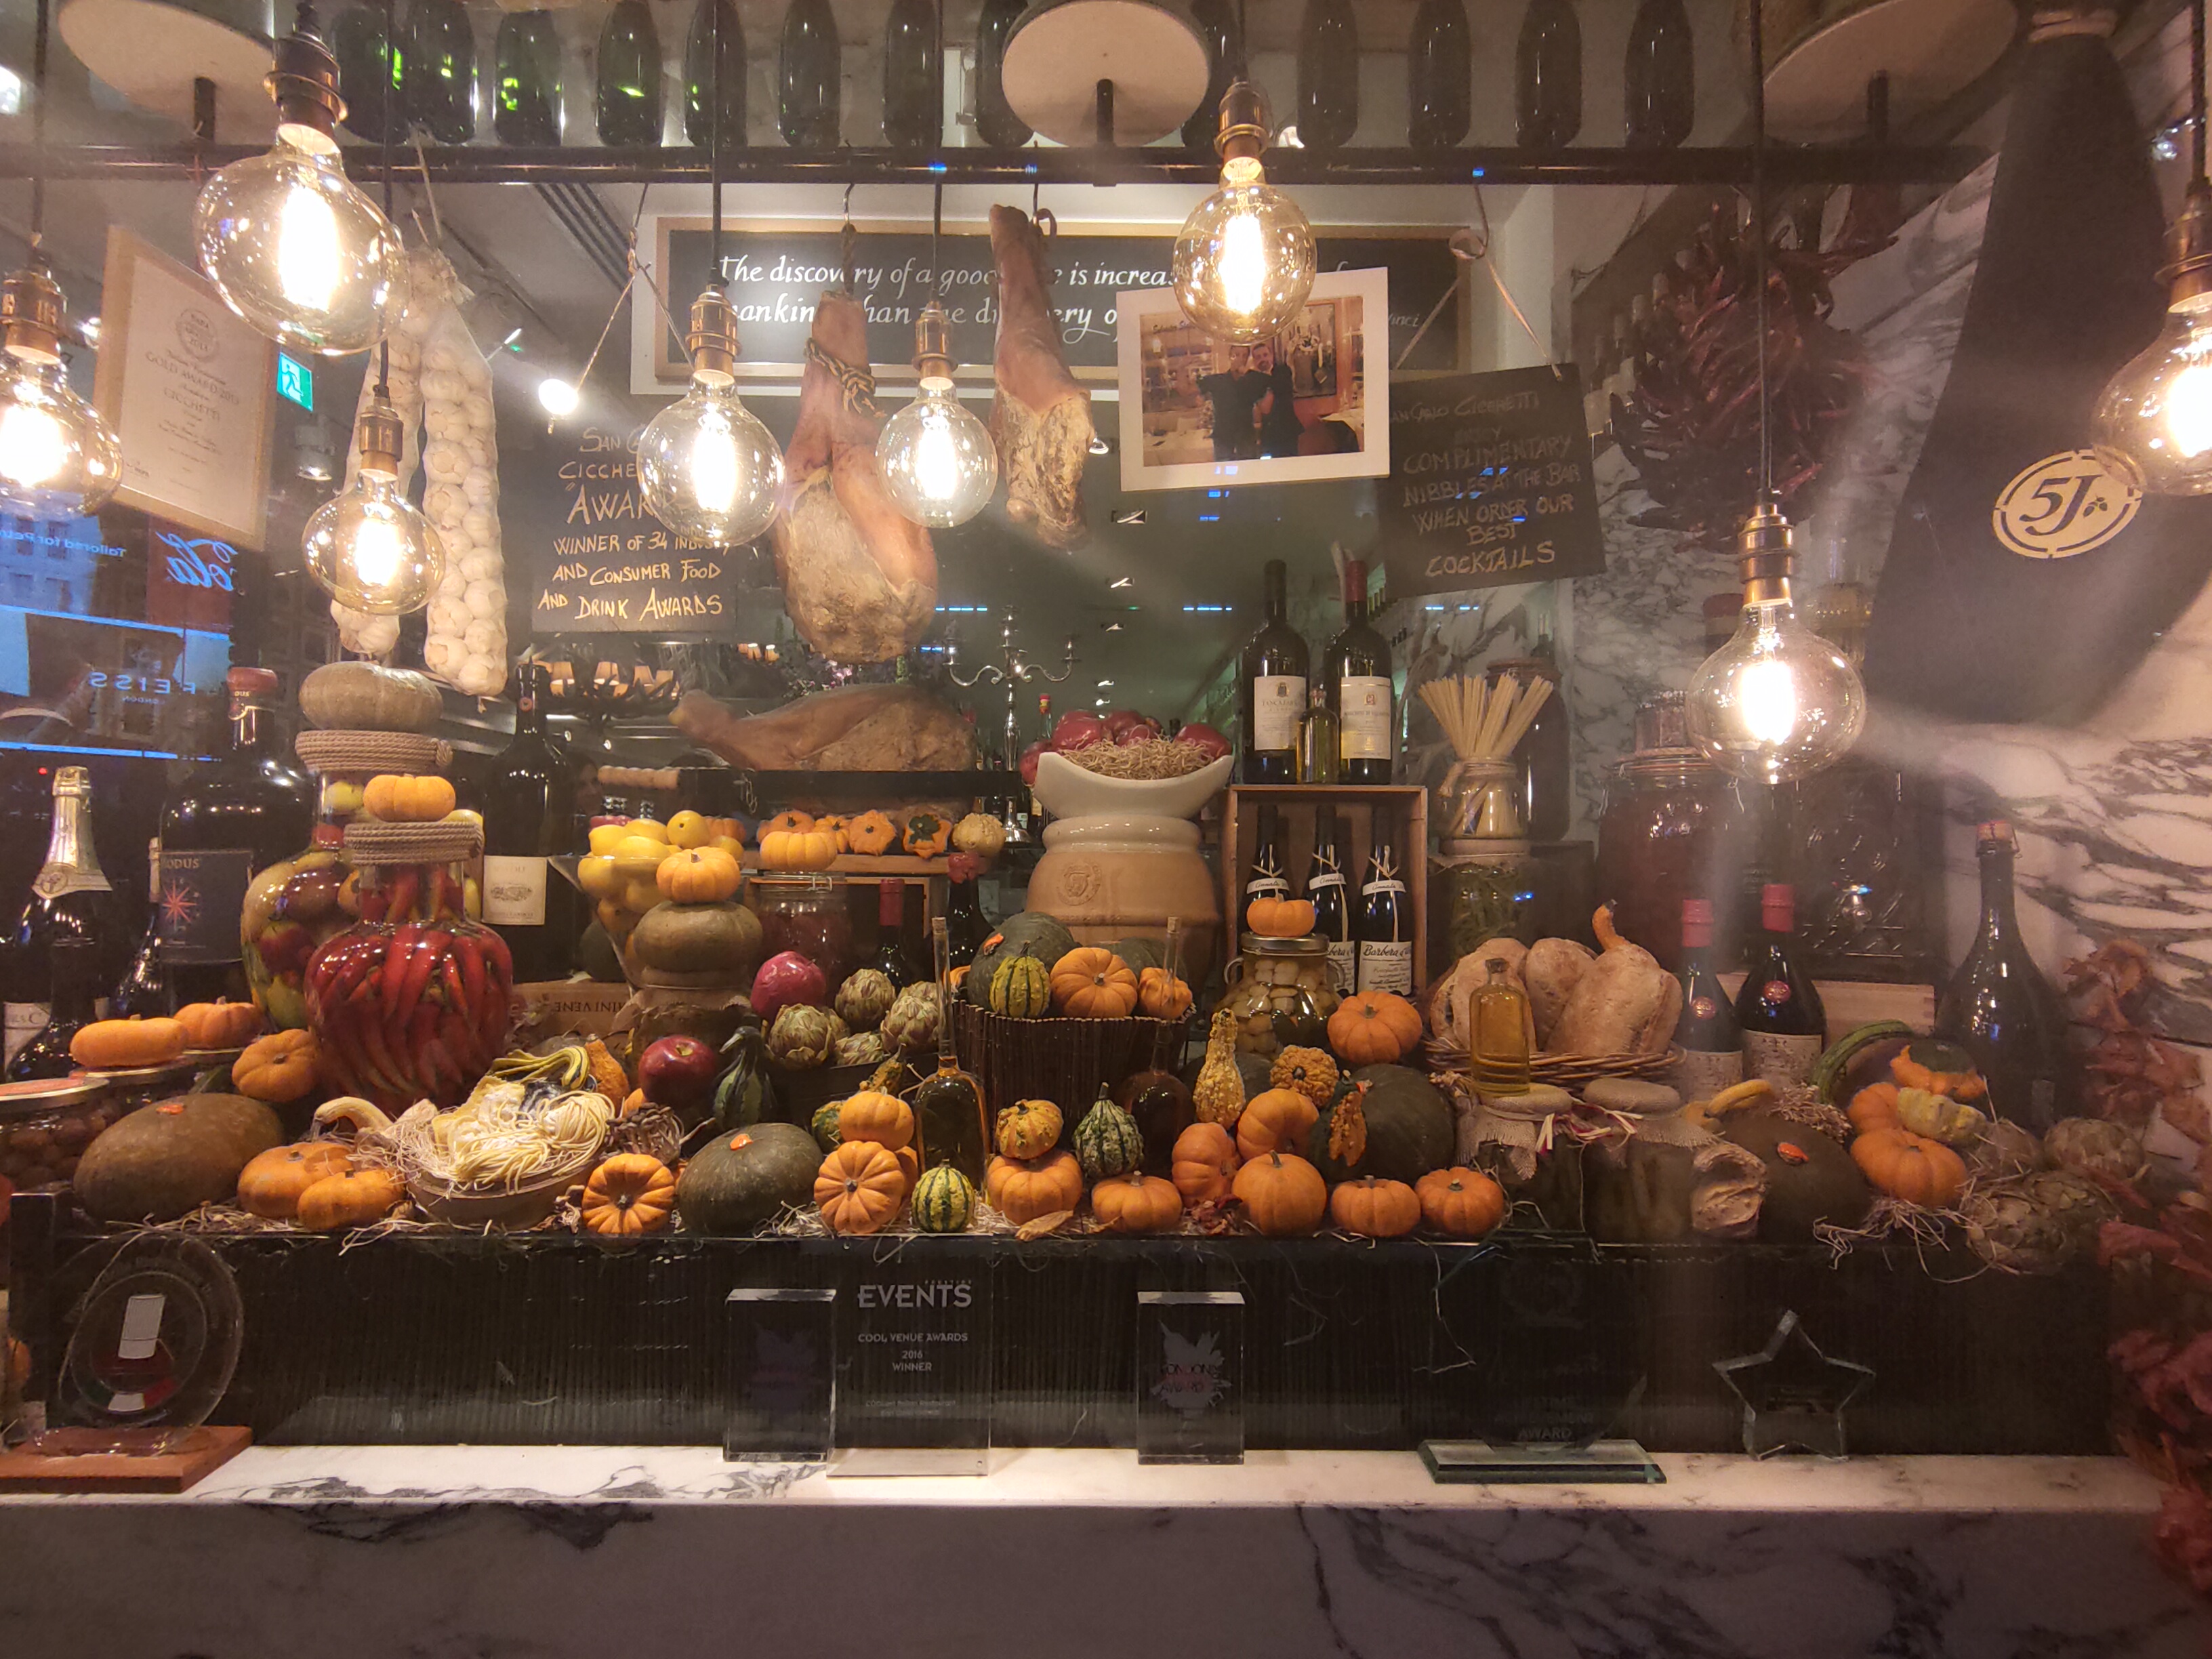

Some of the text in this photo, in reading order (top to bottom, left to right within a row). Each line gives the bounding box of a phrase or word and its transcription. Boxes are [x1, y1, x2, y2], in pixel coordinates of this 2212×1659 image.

[719, 253, 764, 283] The
[890, 257, 916, 300] of
[916, 266, 933, 283] a
[1069, 261, 1088, 286] is
[731, 291, 815, 323] ankin
[863, 293, 912, 325] han
[558, 460, 638, 479] CICCHE
[1546, 462, 1582, 487] BAR
[1412, 507, 1469, 536] WHEN
[1536, 493, 1575, 514] OUR
[2019, 474, 2103, 537] 5J
[553, 534, 620, 556] WINNER
[648, 531, 668, 550] 34
[1466, 522, 1519, 546] BEST
[1425, 540, 1556, 577] COCKTAILS
[552, 558, 722, 586] AND CONSUMER FOOD
[537, 587, 723, 621] AND DRINK AWARDS
[1363, 944, 1399, 958] Barbera
[857, 1284, 972, 1308] EVENTS
[857, 1332, 968, 1344] COOL VENUE AWARDS
[892, 1361, 933, 1372] WINNER
[901, 1350, 923, 1359] 2016
[1517, 1427, 1573, 1439] AWARD
